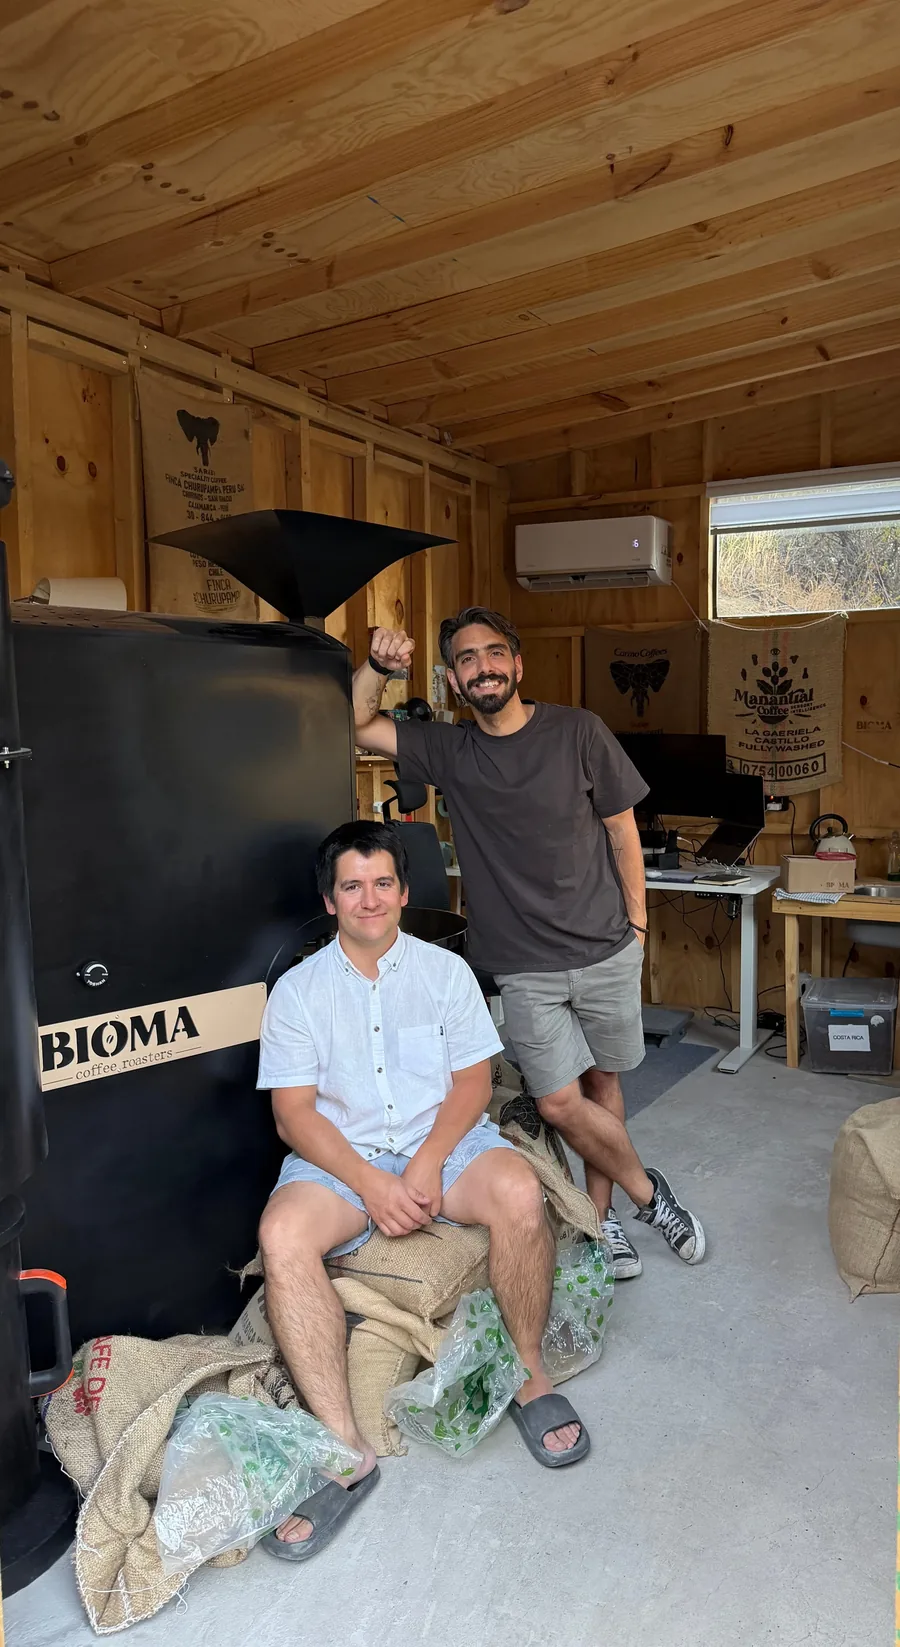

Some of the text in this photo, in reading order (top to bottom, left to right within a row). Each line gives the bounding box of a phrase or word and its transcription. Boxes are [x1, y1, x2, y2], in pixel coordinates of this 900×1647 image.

[165, 473, 182, 488] FINCA
[206, 579, 232, 591] FINCA
[733, 688, 814, 709] Manantial
[757, 705, 789, 715] Coffee
[745, 728, 760, 736] LA
[738, 739, 825, 752] FULLY WASHED
[754, 736, 810, 745] CASTILLO
[743, 763, 775, 778] 0754
[779, 761, 819, 778] 00060
[40, 1005, 200, 1072] BIOMA
[75, 1049, 173, 1080] coffee roasters
